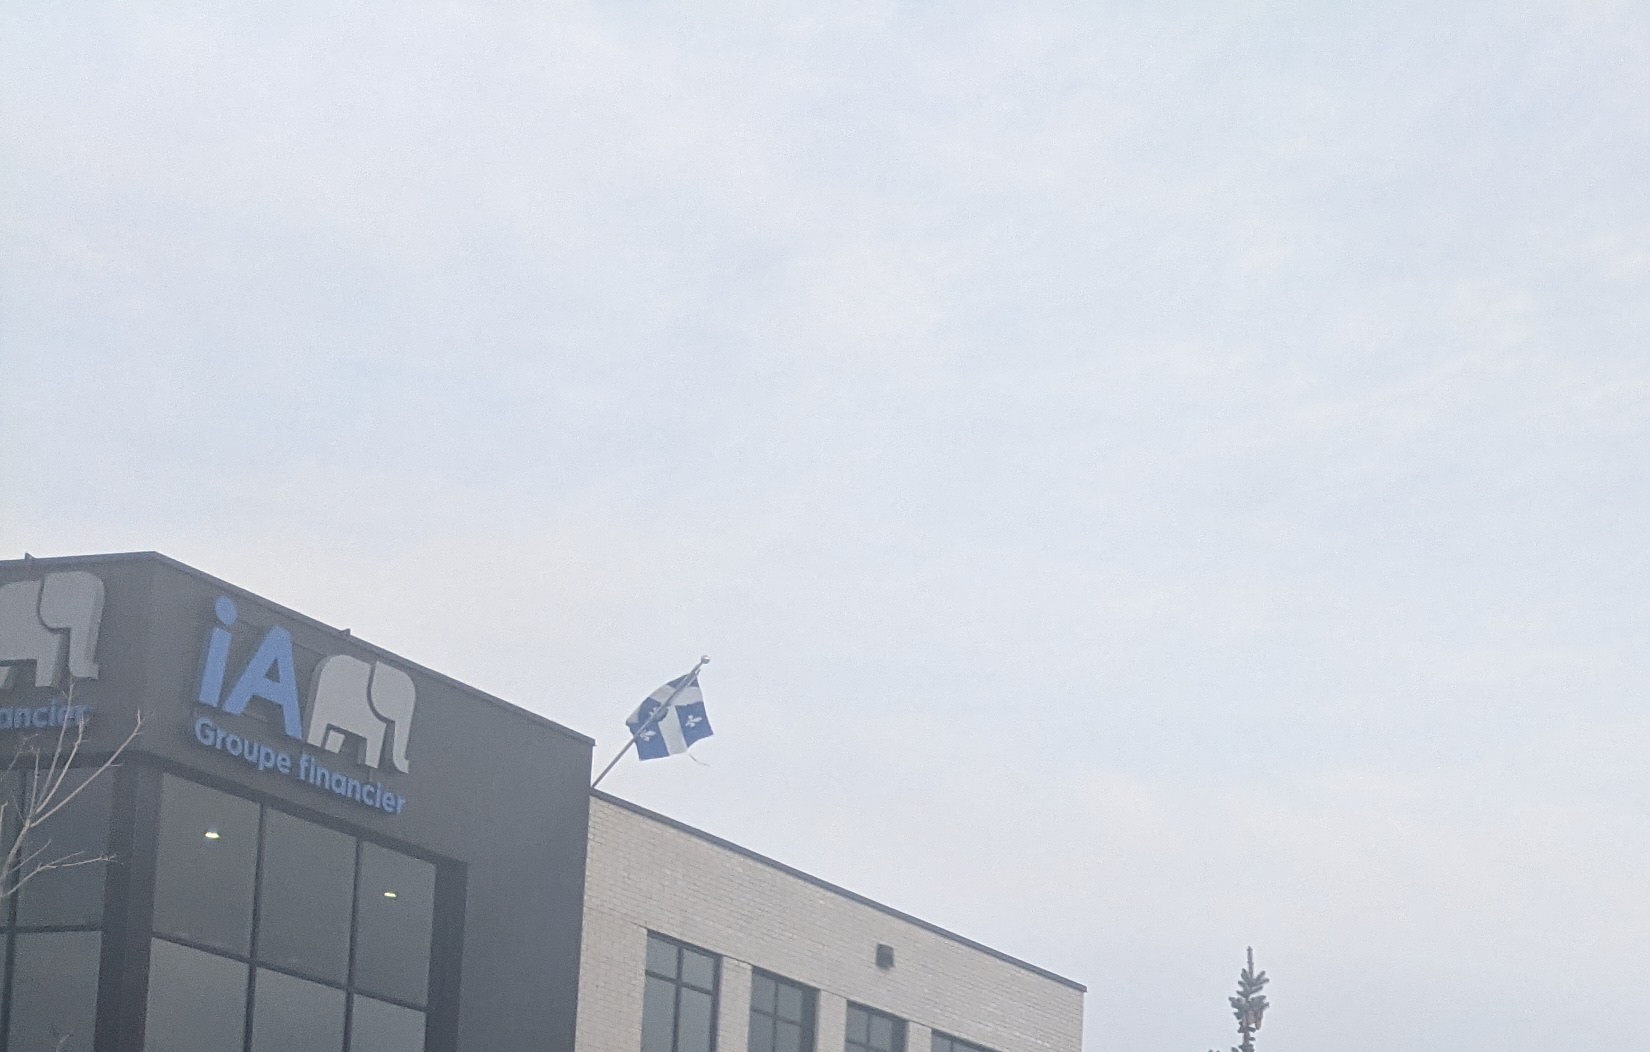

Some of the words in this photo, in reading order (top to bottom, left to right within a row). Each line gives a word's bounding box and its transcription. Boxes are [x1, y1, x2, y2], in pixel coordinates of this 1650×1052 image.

[199, 596, 303, 740] iA
[195, 717, 292, 774] Groupe
[299, 754, 405, 815] financier
